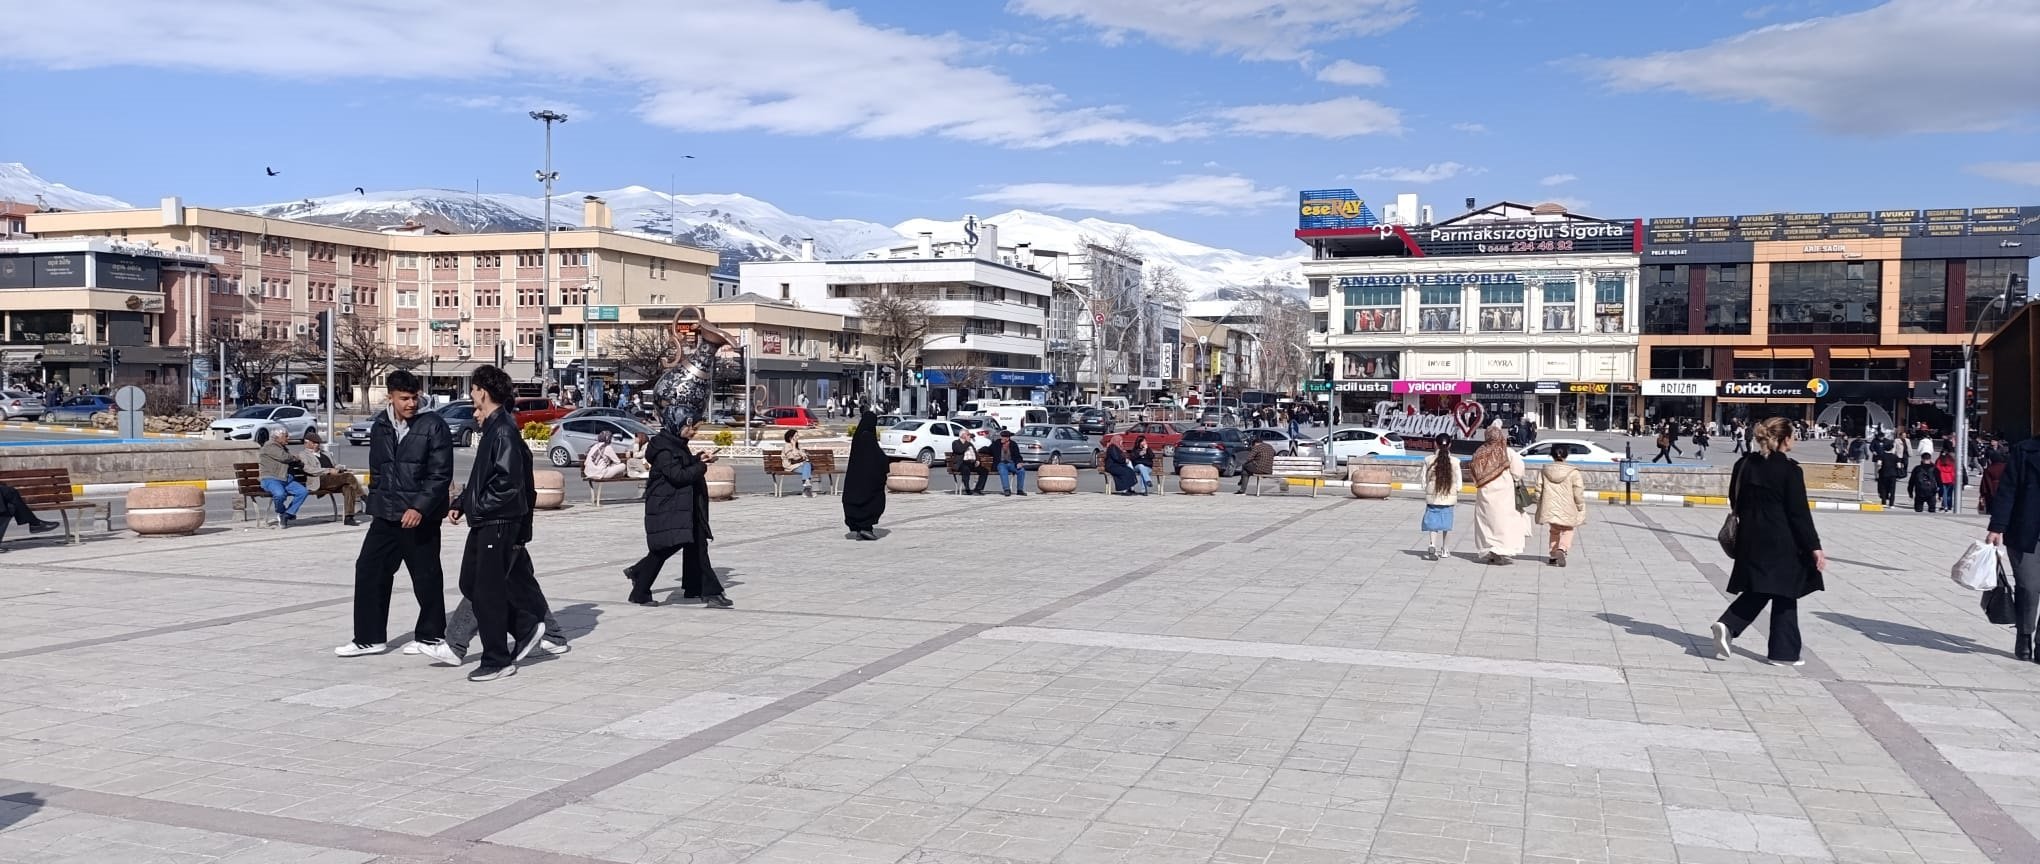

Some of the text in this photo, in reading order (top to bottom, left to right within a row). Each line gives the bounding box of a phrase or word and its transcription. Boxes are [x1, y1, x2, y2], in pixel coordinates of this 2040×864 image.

[1430, 224, 1623, 242] Parmaksızoğlu Sigorta
[1339, 276, 1428, 287] ANADOLU
[1408, 381, 1457, 393] yalçınlar
[1725, 382, 1771, 395] florida
